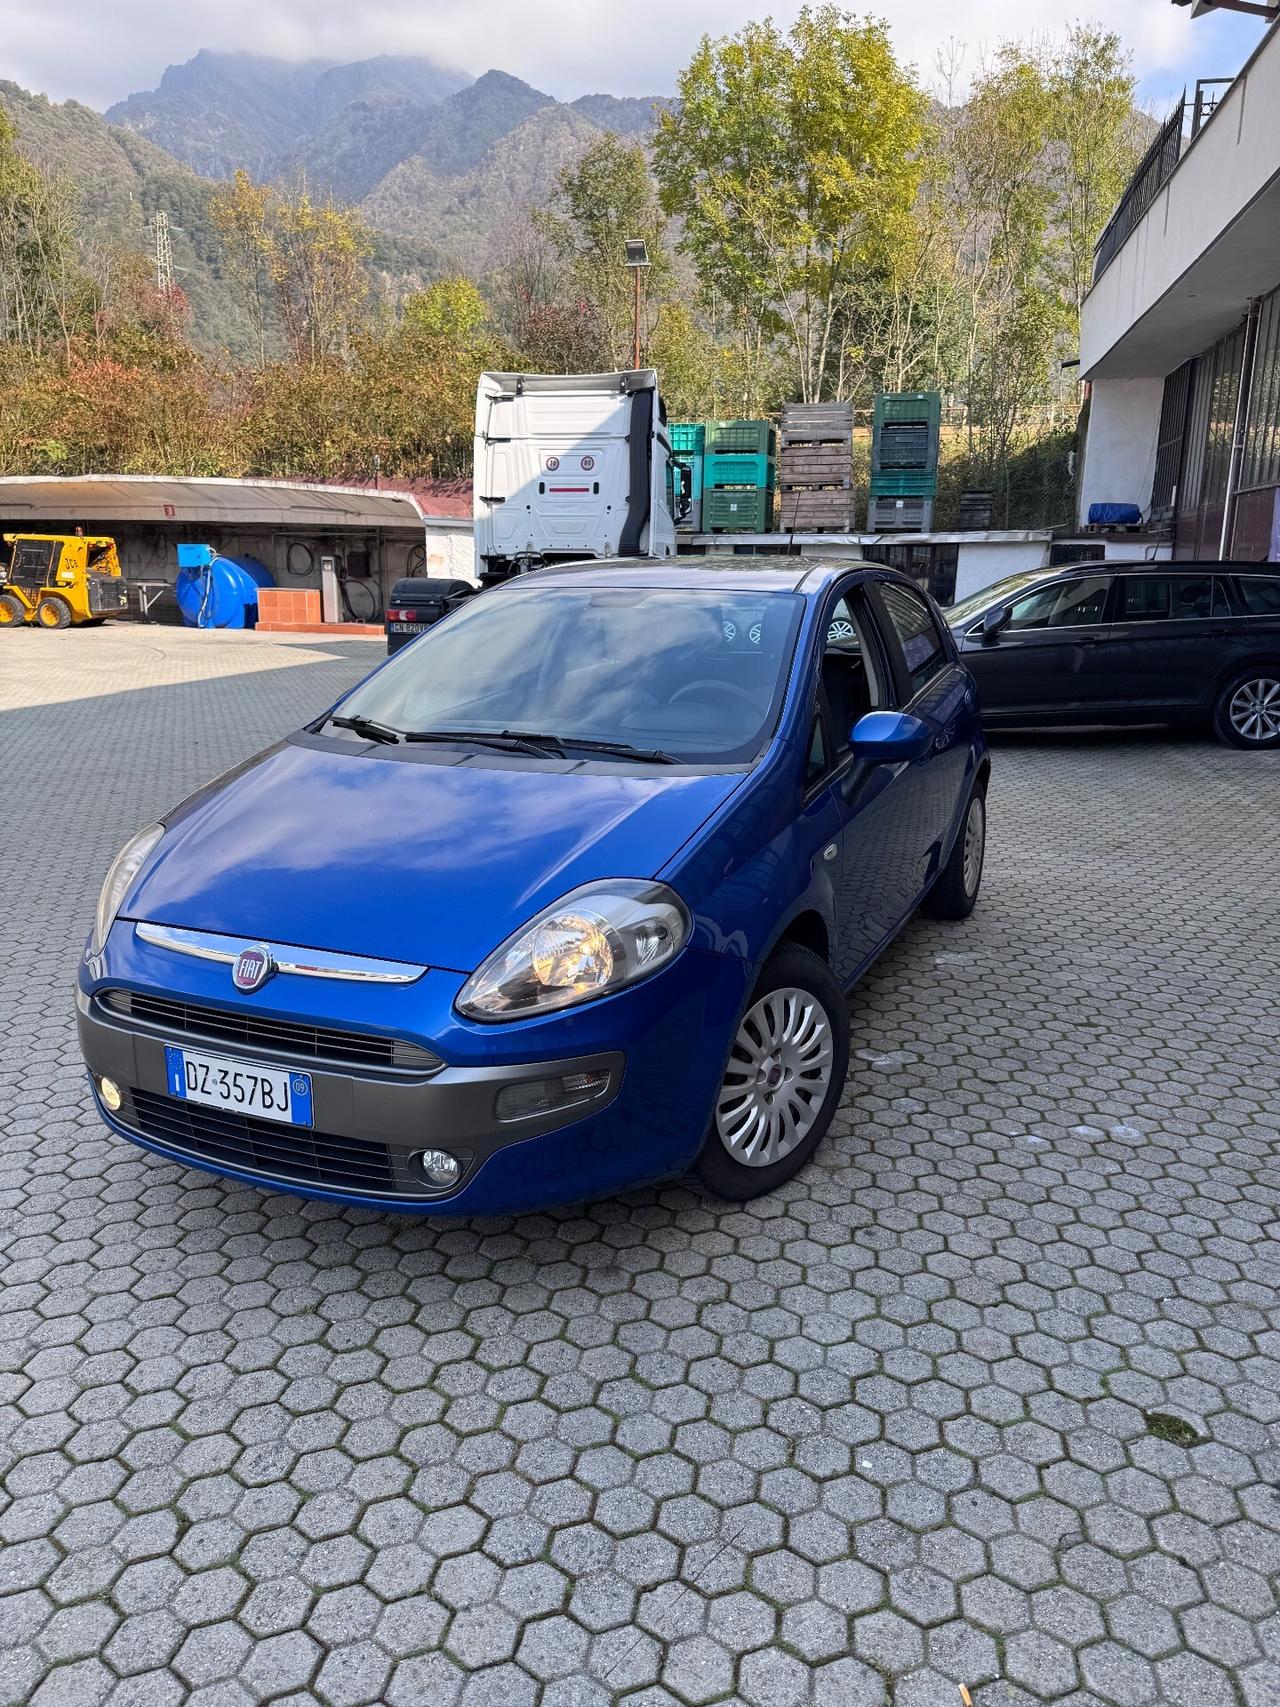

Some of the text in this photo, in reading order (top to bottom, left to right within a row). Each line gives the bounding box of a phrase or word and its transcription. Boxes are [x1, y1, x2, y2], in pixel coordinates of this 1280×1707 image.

[238, 958, 262, 979] FIAT
[185, 1060, 212, 1095] DZ
[217, 1068, 289, 1112] 357BJ
[295, 1082, 305, 1092] 09
